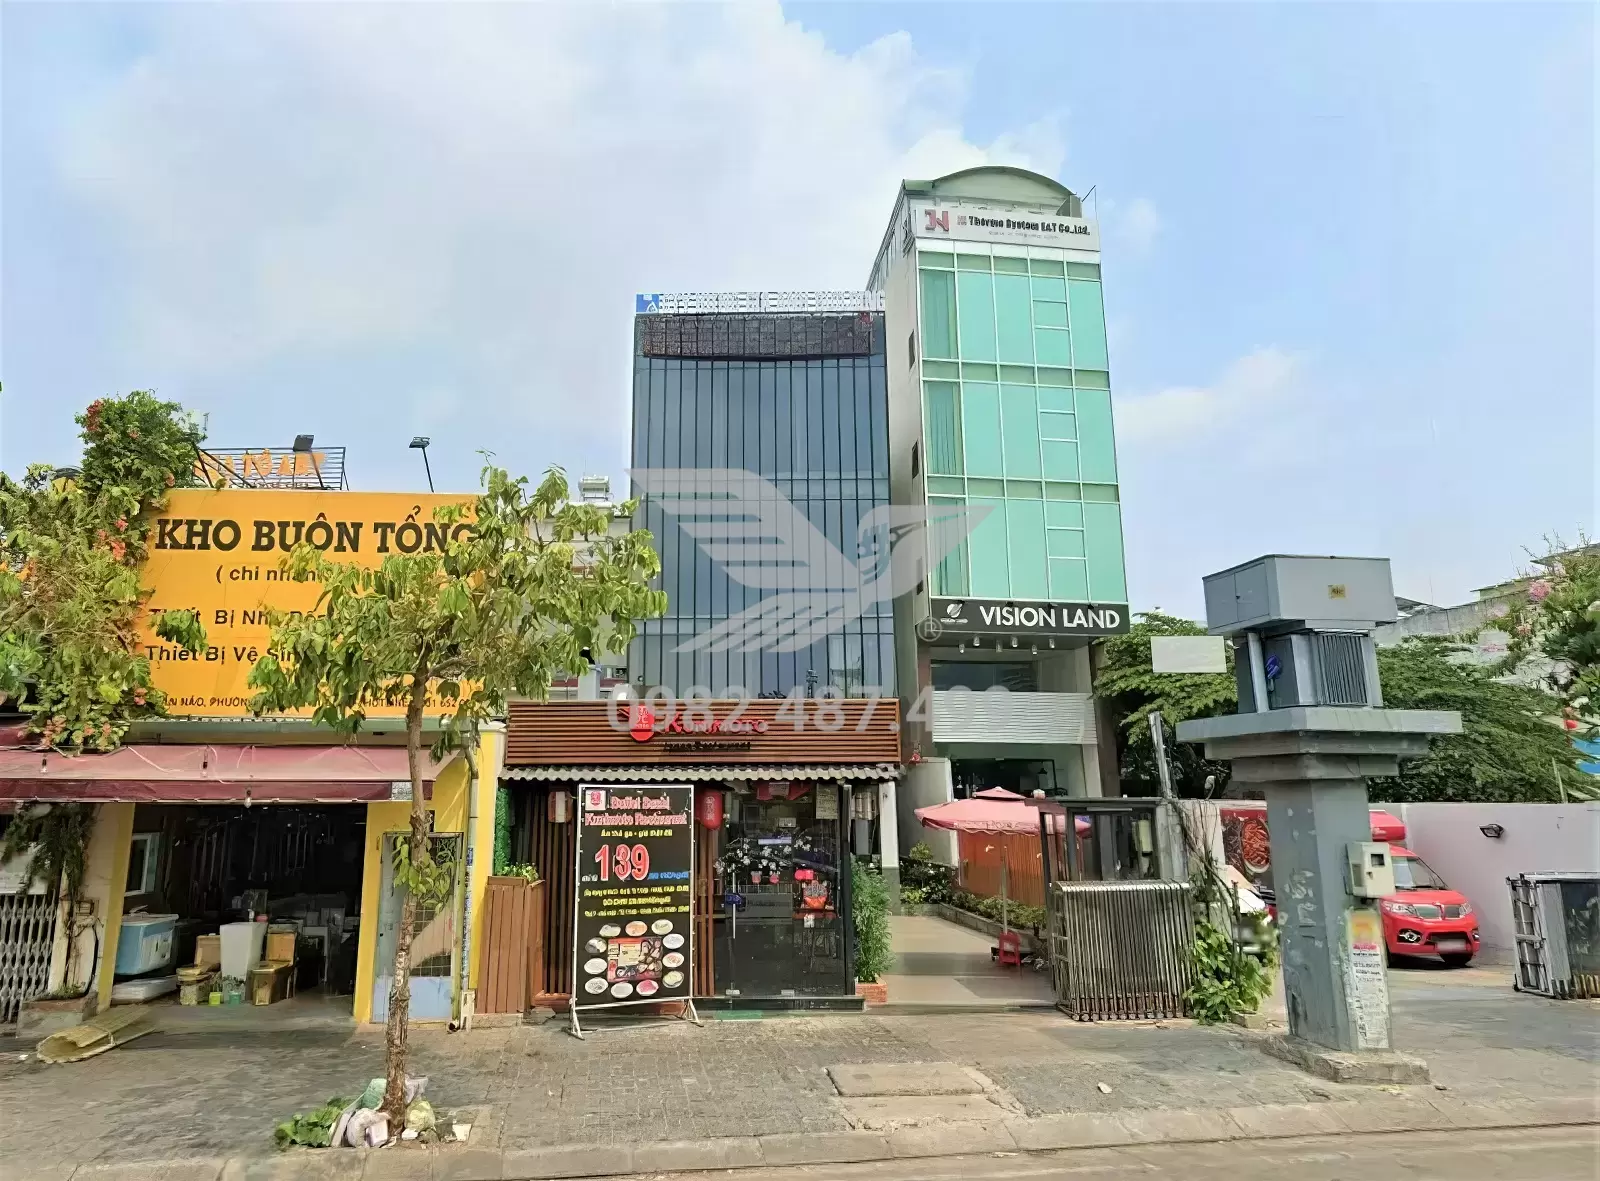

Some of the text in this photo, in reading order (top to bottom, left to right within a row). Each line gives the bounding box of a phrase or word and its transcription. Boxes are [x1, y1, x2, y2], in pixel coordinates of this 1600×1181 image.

[155, 518, 242, 552] KHO
[251, 512, 363, 553] BUÔN
[215, 609, 235, 628] Bị
[979, 605, 1120, 629] VISION LAND
[205, 646, 225, 665] Bị
[233, 645, 259, 665] Vệ
[594, 843, 650, 882] 139
